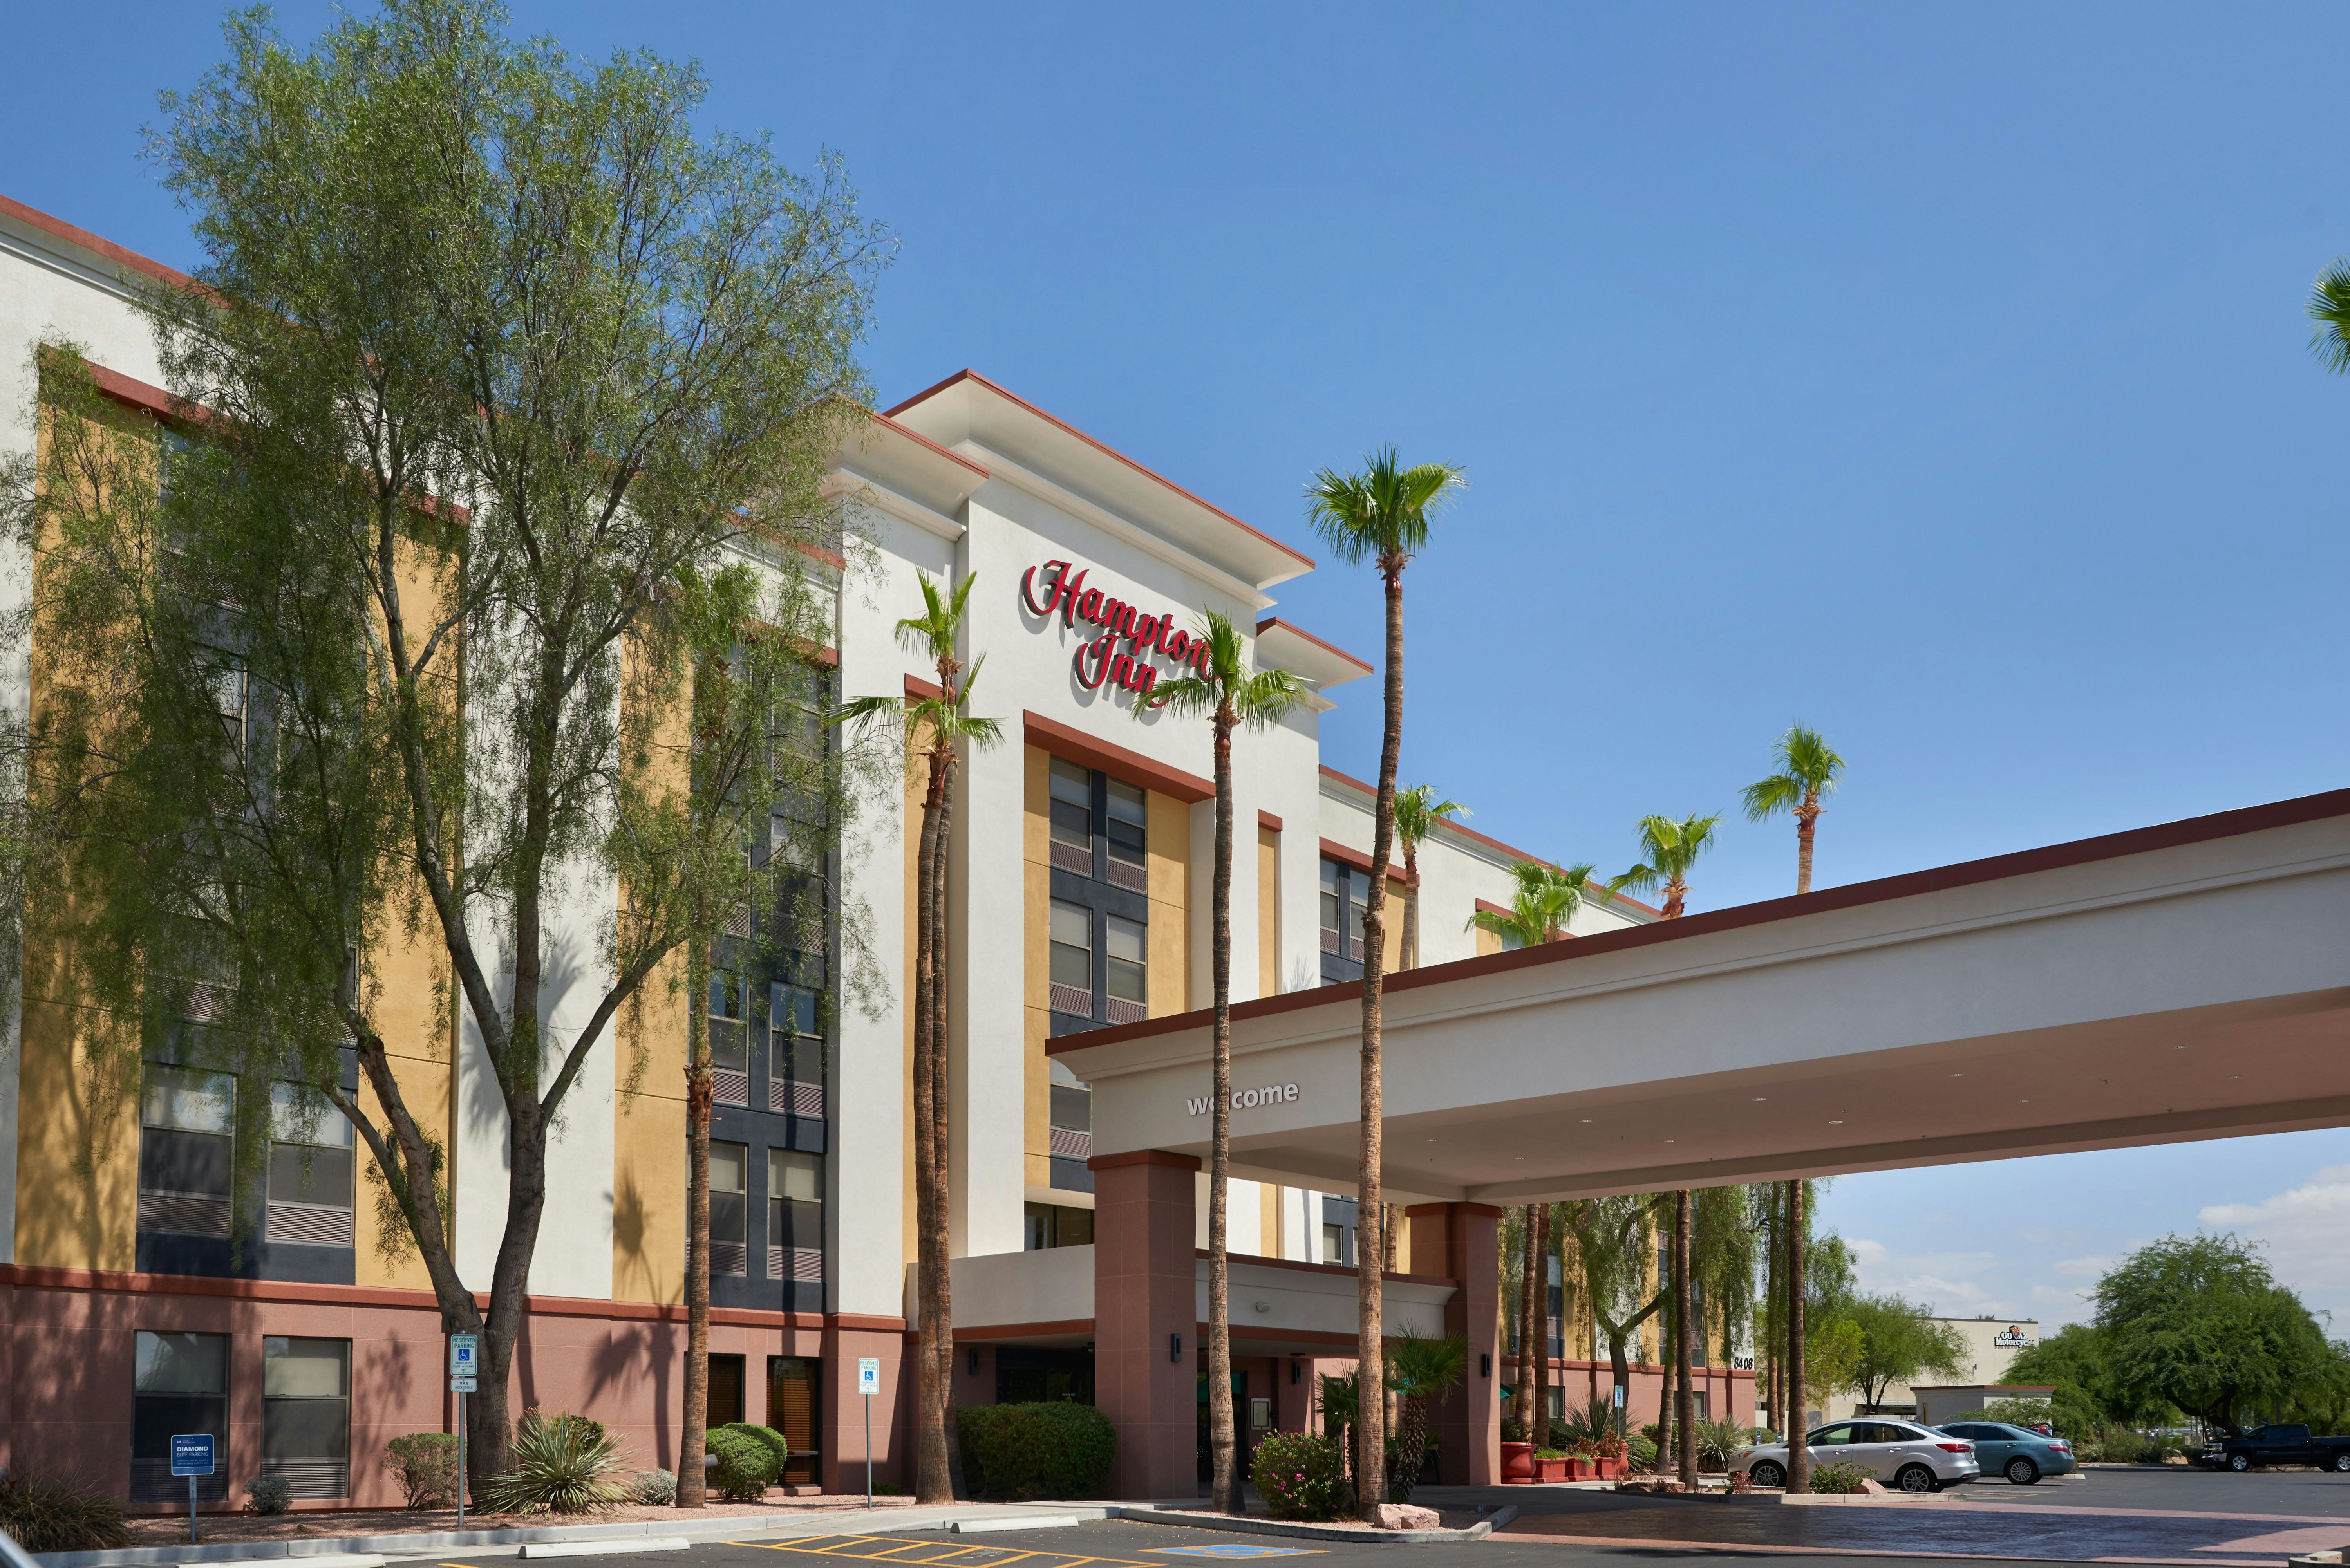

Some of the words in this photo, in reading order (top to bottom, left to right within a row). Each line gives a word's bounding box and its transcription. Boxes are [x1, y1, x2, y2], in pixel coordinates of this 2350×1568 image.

[1022, 560, 1220, 682] Hampton
[1075, 634, 1171, 708] Inn
[1187, 1083, 1299, 1116] wcome
